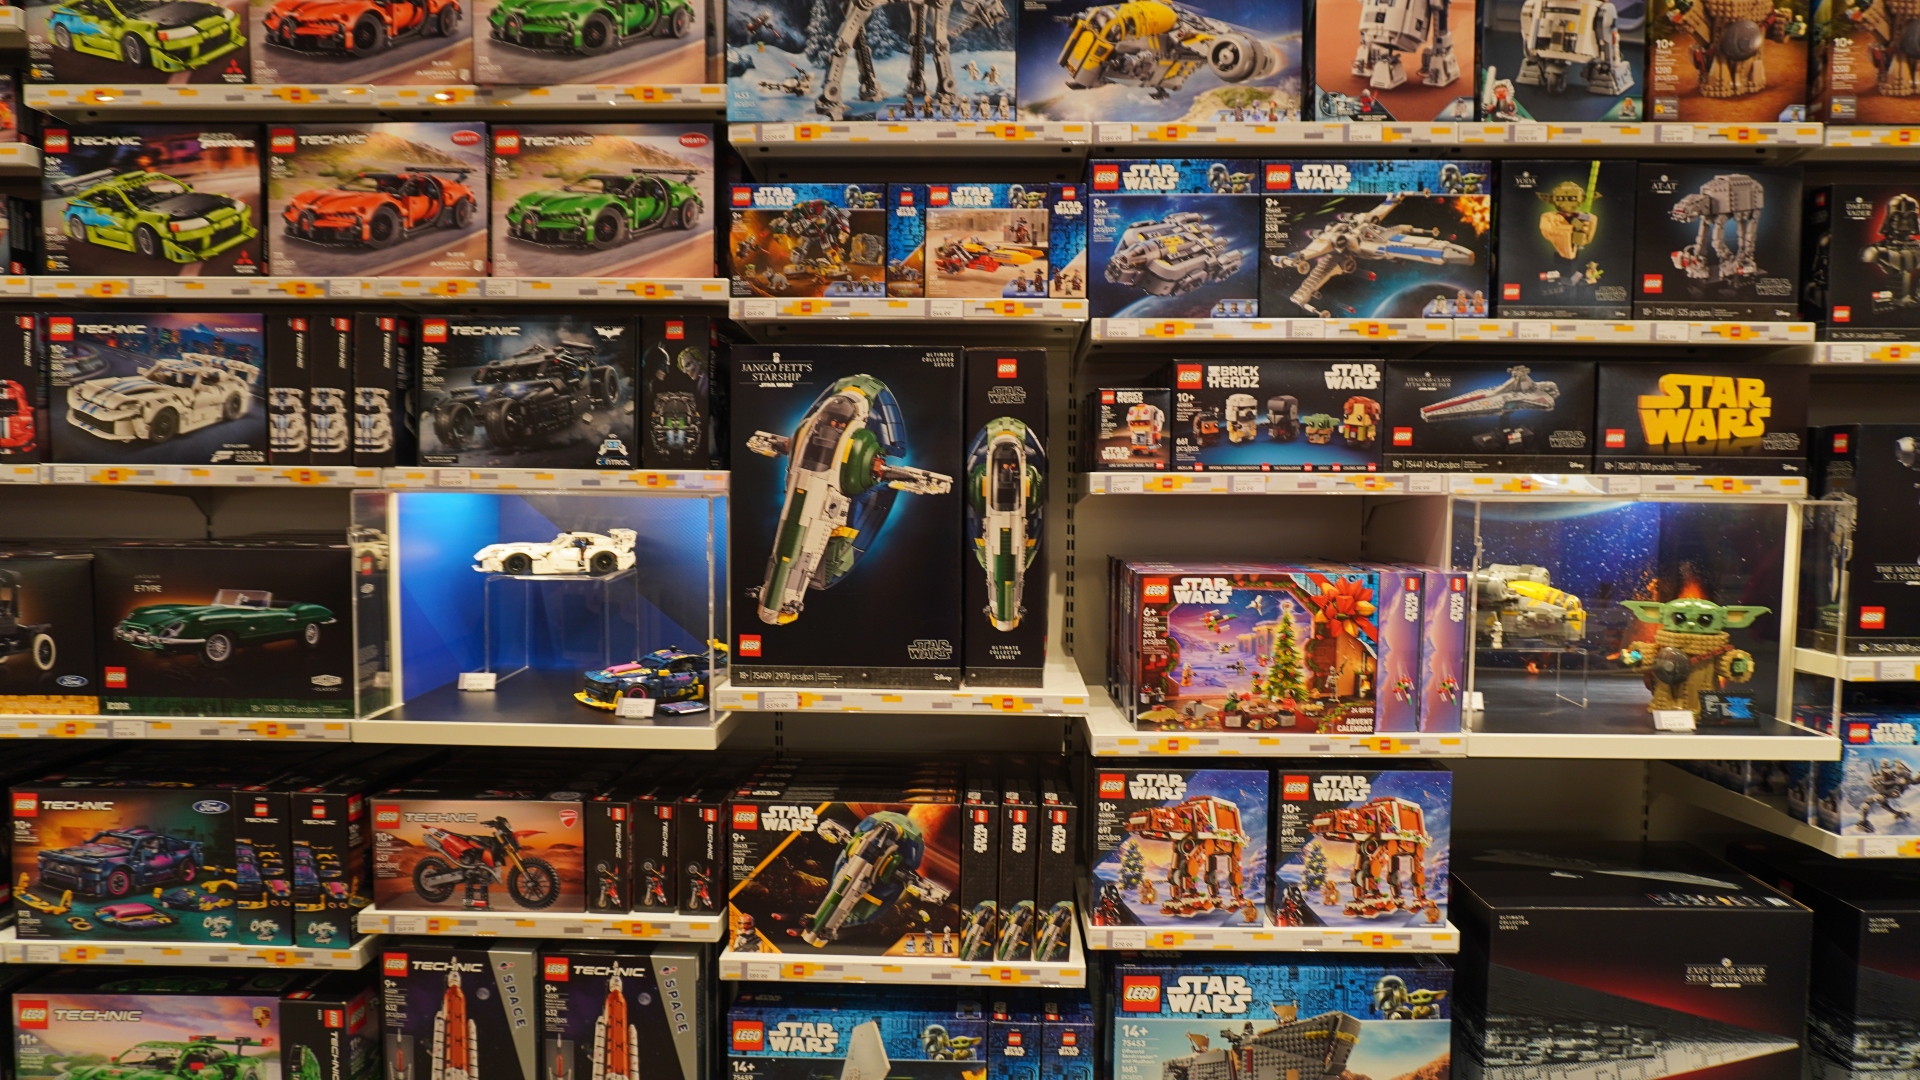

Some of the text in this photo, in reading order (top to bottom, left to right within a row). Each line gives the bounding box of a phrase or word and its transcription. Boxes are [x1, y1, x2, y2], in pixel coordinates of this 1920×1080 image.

[1655, 39, 1674, 50] 10+
[1833, 37, 1854, 48] 10+
[73, 136, 143, 147] TECHNIC
[300, 135, 368, 146] TECHNIC
[523, 136, 593, 147] TECHNIC
[1095, 171, 1118, 183] LEGO
[1122, 164, 1180, 178] STAR
[1267, 171, 1291, 183] LEGO
[1294, 164, 1352, 178] STAR
[1123, 177, 1180, 191] WARS
[1295, 177, 1352, 191] WARS
[1516, 177, 1538, 185] YODA
[1652, 183, 1678, 191] AT-AT
[757, 186, 795, 197] STAR
[955, 186, 993, 197] STAR
[753, 196, 796, 207] WARS
[951, 196, 994, 207] WARS
[1093, 198, 1108, 208] 9+
[1266, 198, 1280, 208] 9+
[1845, 203, 1873, 211] DARTH
[77, 325, 148, 335] TECHNIC
[450, 326, 522, 337] TECHNIC
[296, 332, 305, 369] TECHNIC
[338, 332, 347, 369] TECHNIC
[383, 332, 392, 369] TECHNIC
[741, 363, 813, 373] JANGO FETT'S
[1220, 365, 1261, 377] BRICK
[1324, 363, 1381, 377] STAR
[752, 372, 802, 382] STARSHIP
[1178, 371, 1202, 383] LEGO
[1208, 376, 1261, 389] HEADZ
[1324, 375, 1381, 390] WARS
[988, 386, 1026, 396] STAR
[1637, 373, 1772, 409] STAR
[988, 394, 1027, 404] WARS
[1177, 393, 1196, 403] 10+
[1637, 407, 1772, 446] WARS
[1103, 446, 1138, 454] STAR
[1101, 452, 1138, 461] WARS
[1876, 565, 1893, 574] THE
[134, 584, 162, 593] E-TYPE
[1144, 583, 1170, 596] LEGO
[1172, 577, 1232, 592] STAR
[1173, 590, 1232, 604] WARS
[1143, 607, 1157, 618] 6+
[1143, 630, 1157, 640] 293
[739, 640, 761, 651] LEGO
[907, 639, 954, 651] STAR
[908, 649, 954, 660] WARS
[739, 671, 791, 681] 18+ 75409 2970
[1359, 706, 1374, 715] GIFTS
[1345, 717, 1374, 727] ADVENT
[1336, 724, 1374, 735] CALENDAR
[1871, 722, 1917, 735] STAR
[1872, 732, 1916, 744] WARS
[1100, 780, 1125, 793] LEGO
[1128, 774, 1187, 788] STAR
[1283, 781, 1309, 793] LEGO
[1313, 776, 1372, 789] STAR
[1128, 786, 1187, 800] WARS
[1313, 788, 1372, 802] WARS
[41, 800, 115, 811] TECHNIC
[198, 801, 223, 813] Ford
[1098, 802, 1118, 812] 10+
[1281, 804, 1301, 814] 10+
[376, 812, 478, 824] LEGO TECHNIC
[733, 812, 757, 824] LEGO
[760, 805, 819, 820] STAR
[14, 821, 32, 831] 10+
[761, 817, 819, 832] WARS
[1098, 826, 1112, 835] 697
[376, 832, 394, 842] 10+
[732, 832, 746, 843] 9+
[1281, 828, 1296, 838] 697
[615, 822, 623, 859] TECHNIC
[661, 821, 669, 858] TECHNIC
[706, 823, 714, 861] TECHNIC
[732, 857, 745, 866] 707
[385, 958, 484, 973] LEGO TECHNIC
[545, 963, 646, 978] LEGO TECHNIC
[1686, 966, 1767, 976] EXECUTOR SUPER
[384, 979, 398, 988] 9+
[1685, 973, 1710, 983] STAR
[545, 983, 558, 993] 9+
[1166, 975, 1253, 995] STAR
[1124, 986, 1160, 1002] LEGO
[503, 974, 527, 1029] SPACE
[664, 979, 689, 1034] SPACE
[1166, 993, 1253, 1014] WARS
[20, 1007, 143, 1022] LEGO TECHNIC
[768, 1021, 840, 1038] STAR
[1121, 1024, 1150, 1038] 14+
[19, 1033, 39, 1046] 11+
[733, 1029, 763, 1043] LEGO
[768, 1036, 840, 1053] WARS
[1122, 1039, 1147, 1048] 75453
[331, 1031, 341, 1080] TECHNIC
[733, 1060, 756, 1073] 14+
